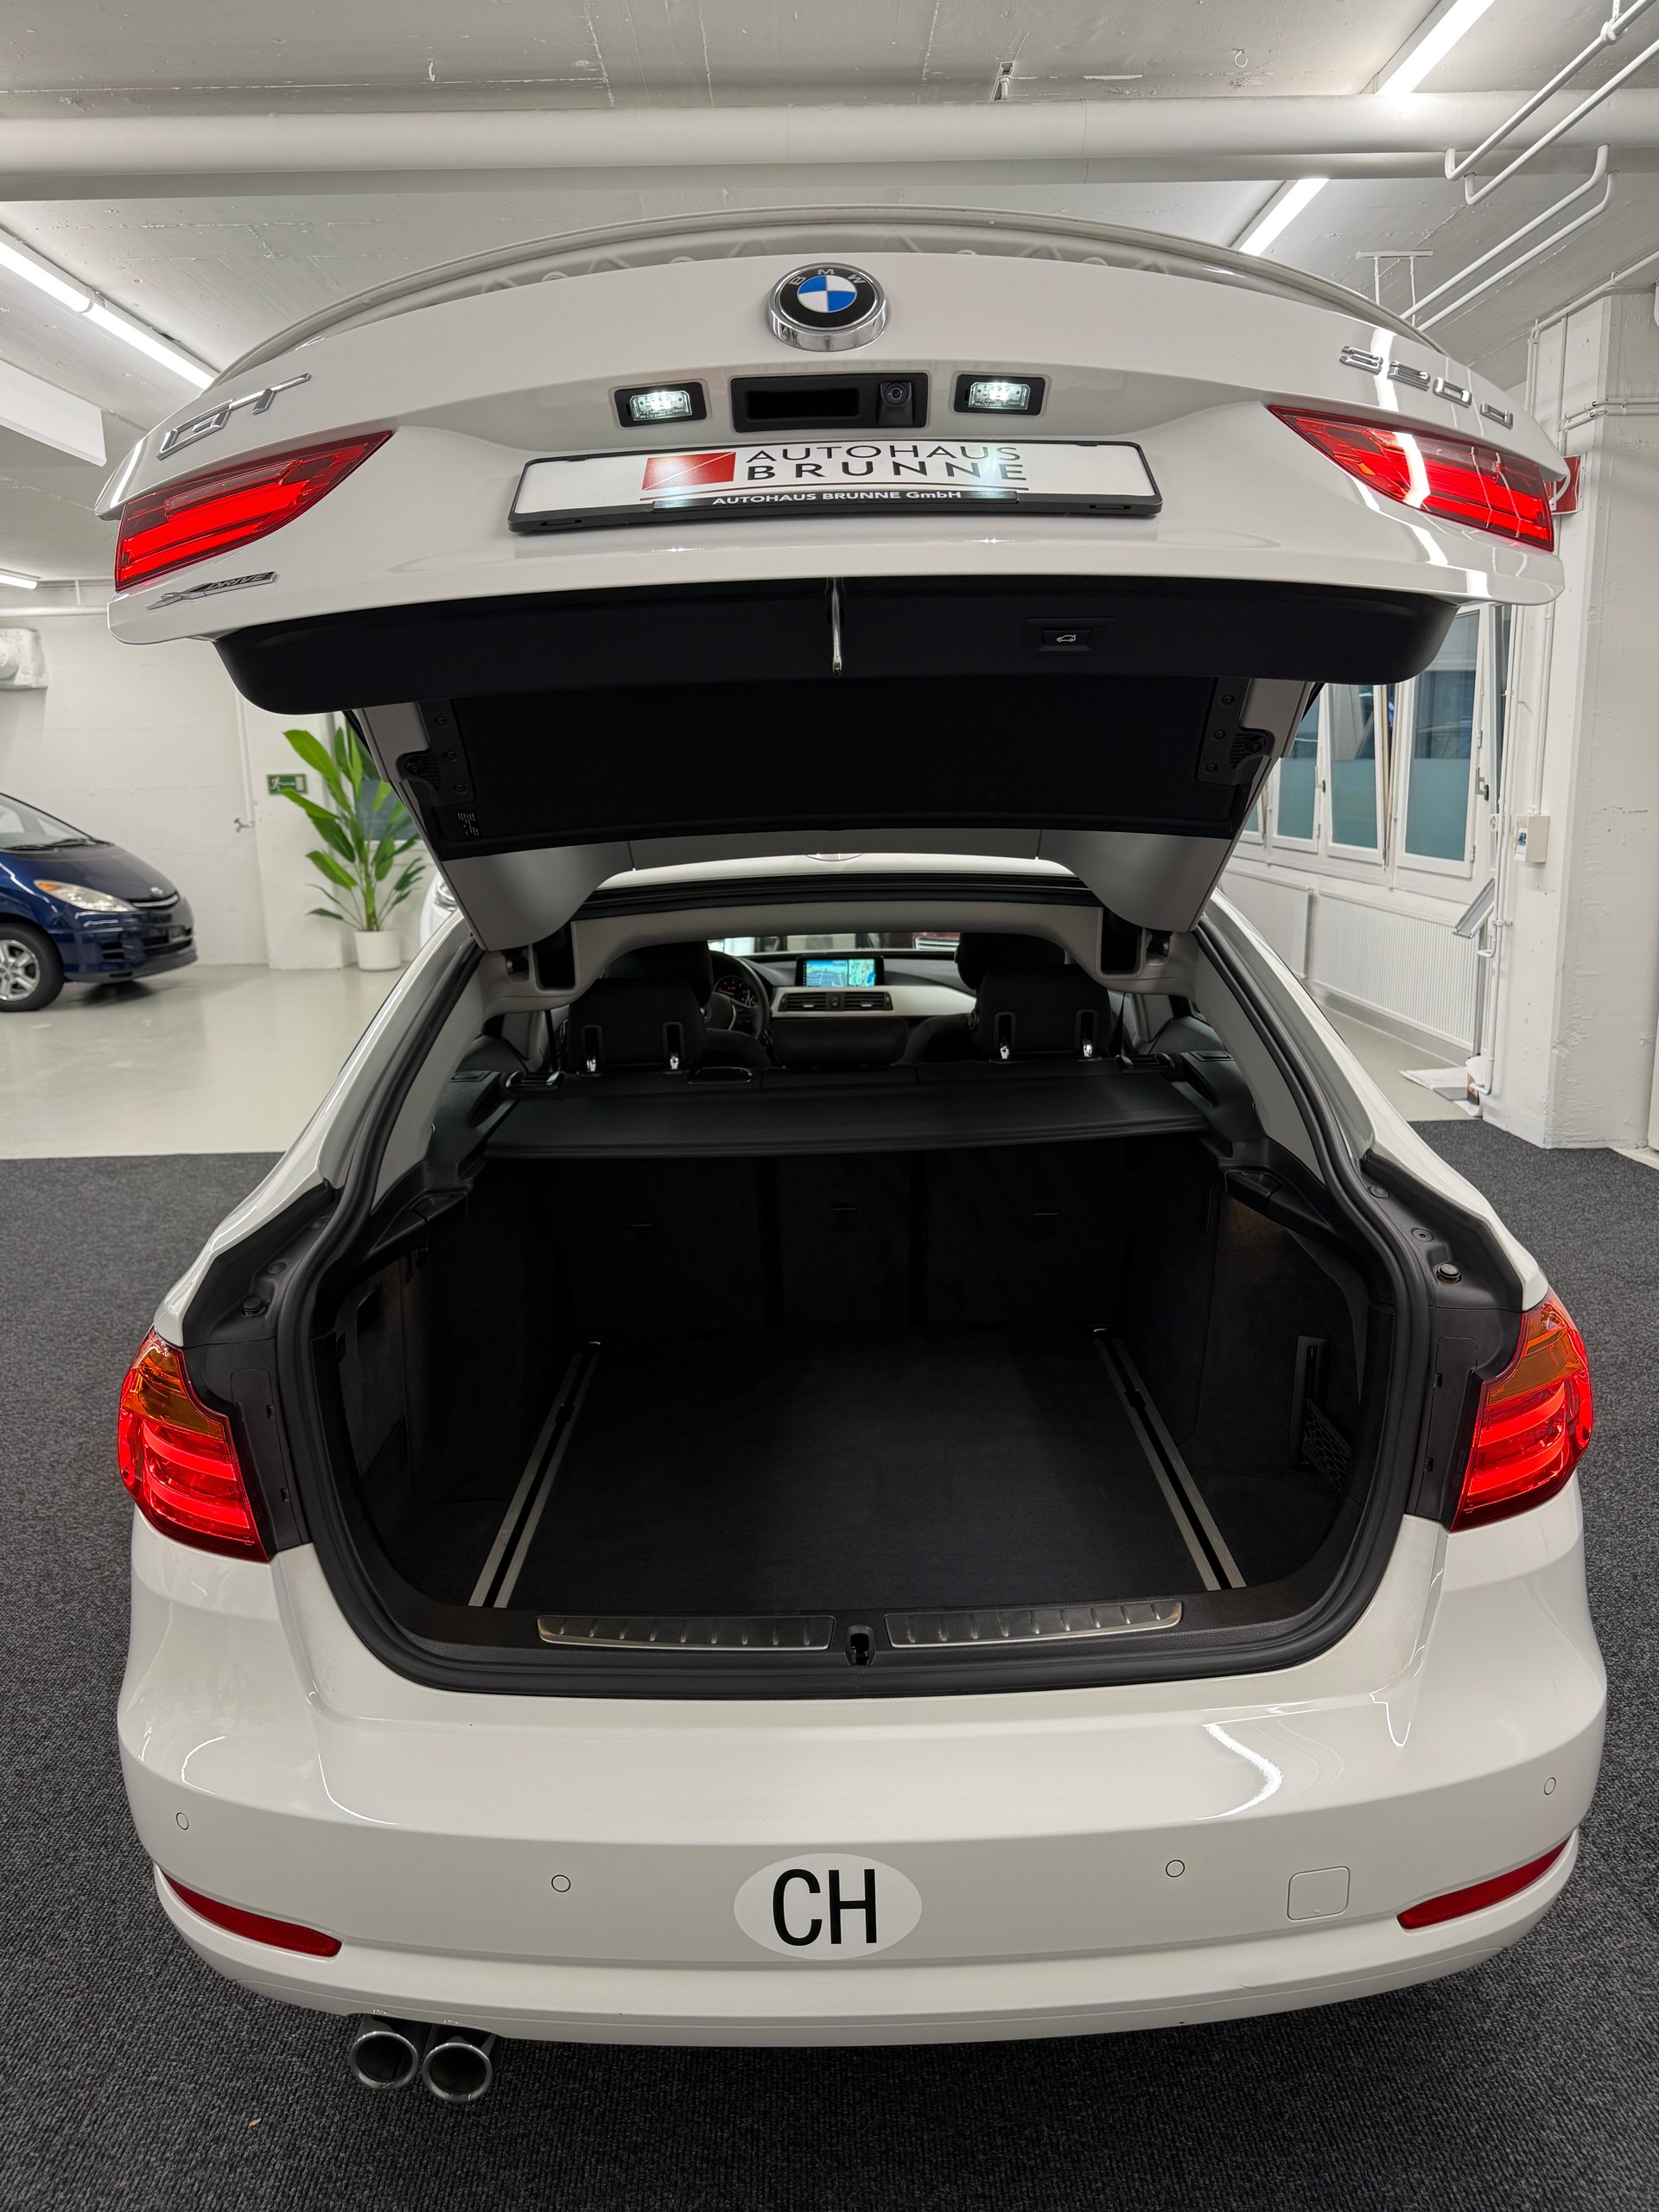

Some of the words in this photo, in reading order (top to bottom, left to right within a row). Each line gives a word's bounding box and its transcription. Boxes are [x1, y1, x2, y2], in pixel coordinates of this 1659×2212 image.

[788, 268, 866, 286] BMW
[156, 372, 311, 461] GT
[746, 445, 1021, 463] AUTOHAUS
[747, 461, 1027, 480] BRUNNE
[712, 493, 817, 505] AUTOHAUS
[823, 491, 900, 499] BRUNNE
[906, 490, 962, 499] GmbH
[772, 1869, 877, 1946] CH
